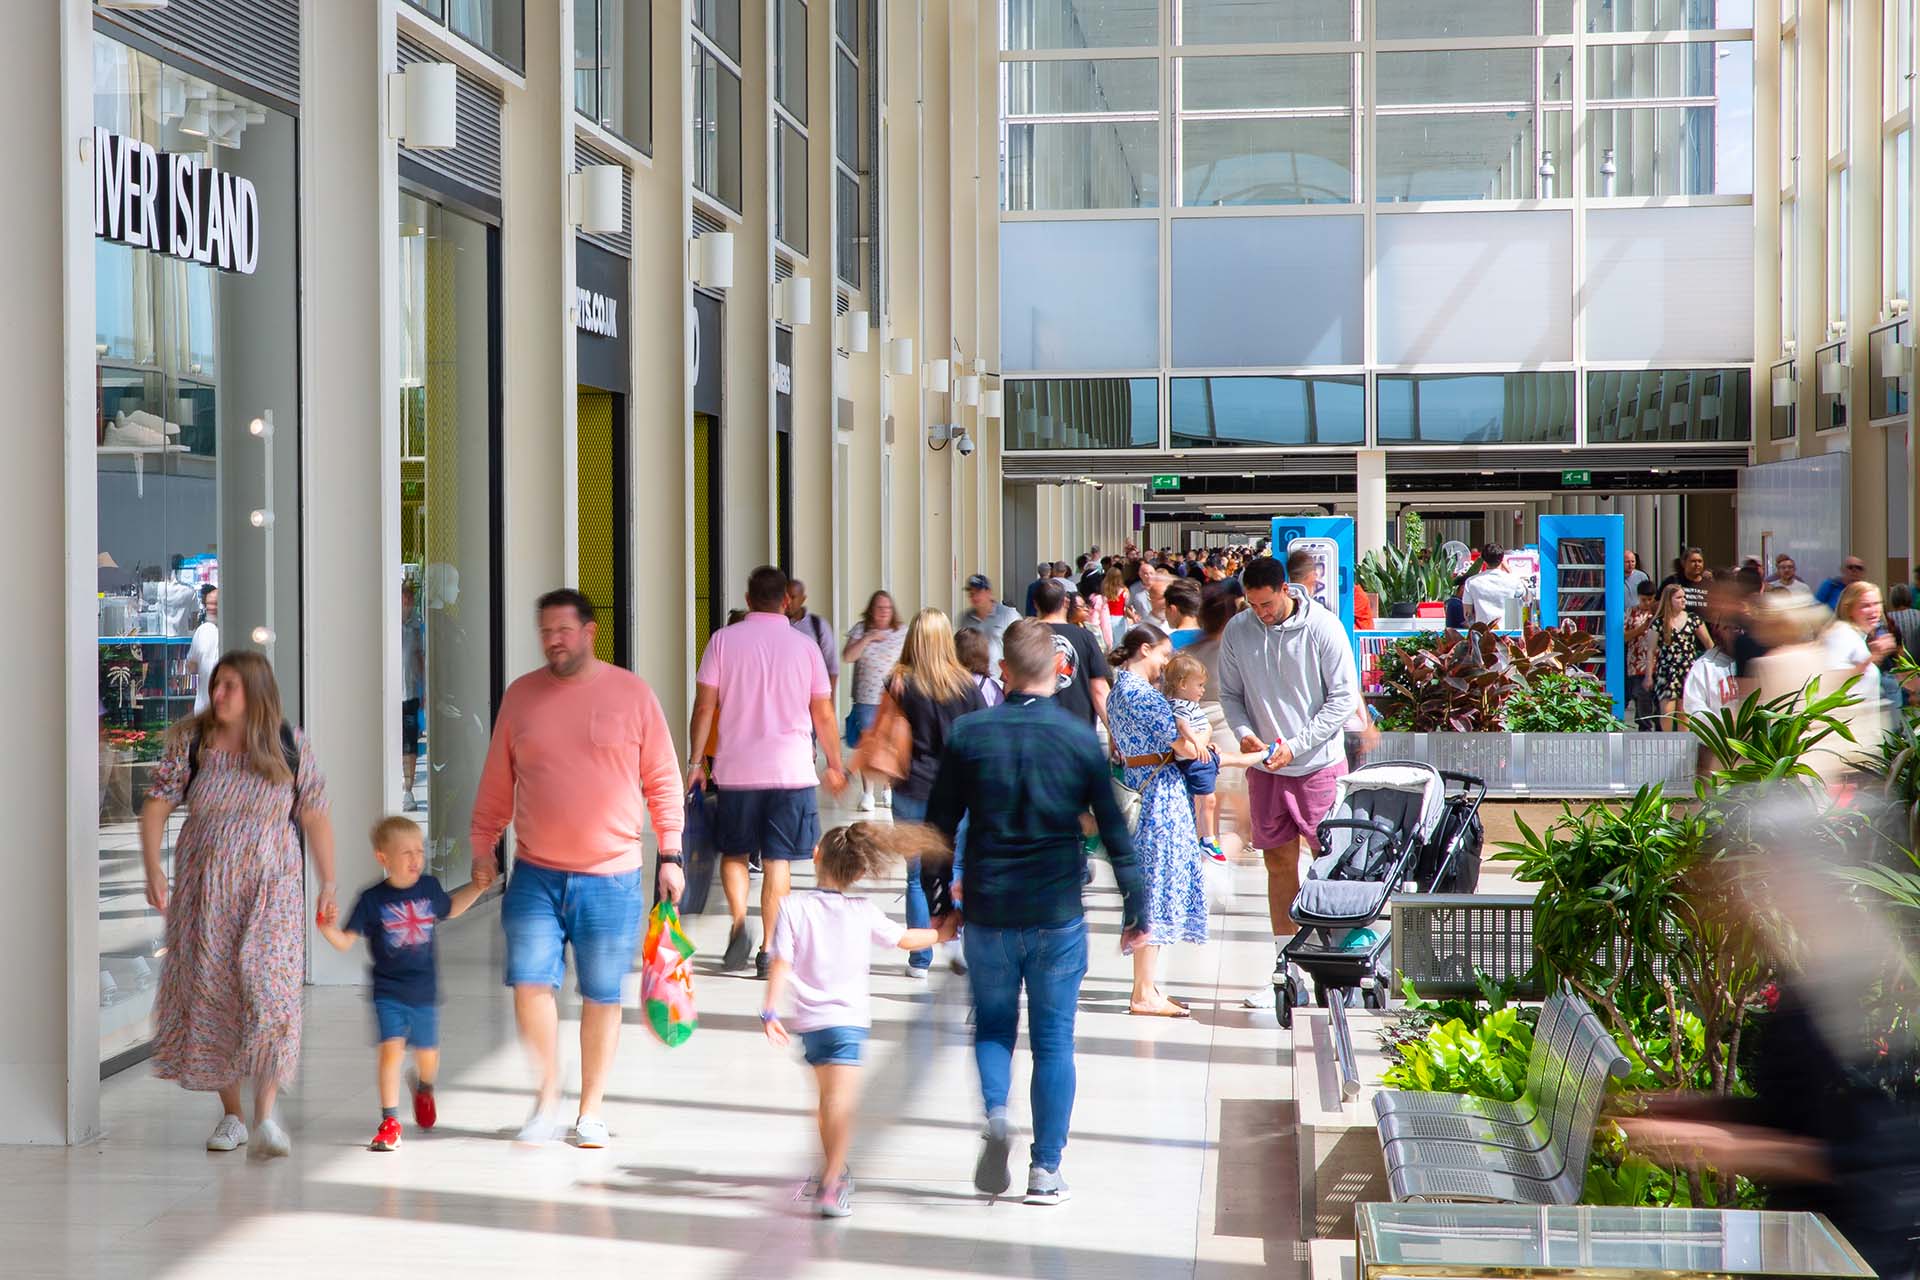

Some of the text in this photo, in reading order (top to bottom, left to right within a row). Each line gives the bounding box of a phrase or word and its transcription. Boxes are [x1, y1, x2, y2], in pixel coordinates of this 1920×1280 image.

[95, 126, 259, 275] IVER ISLAND
[576, 286, 617, 338] RTS.CO.UK
